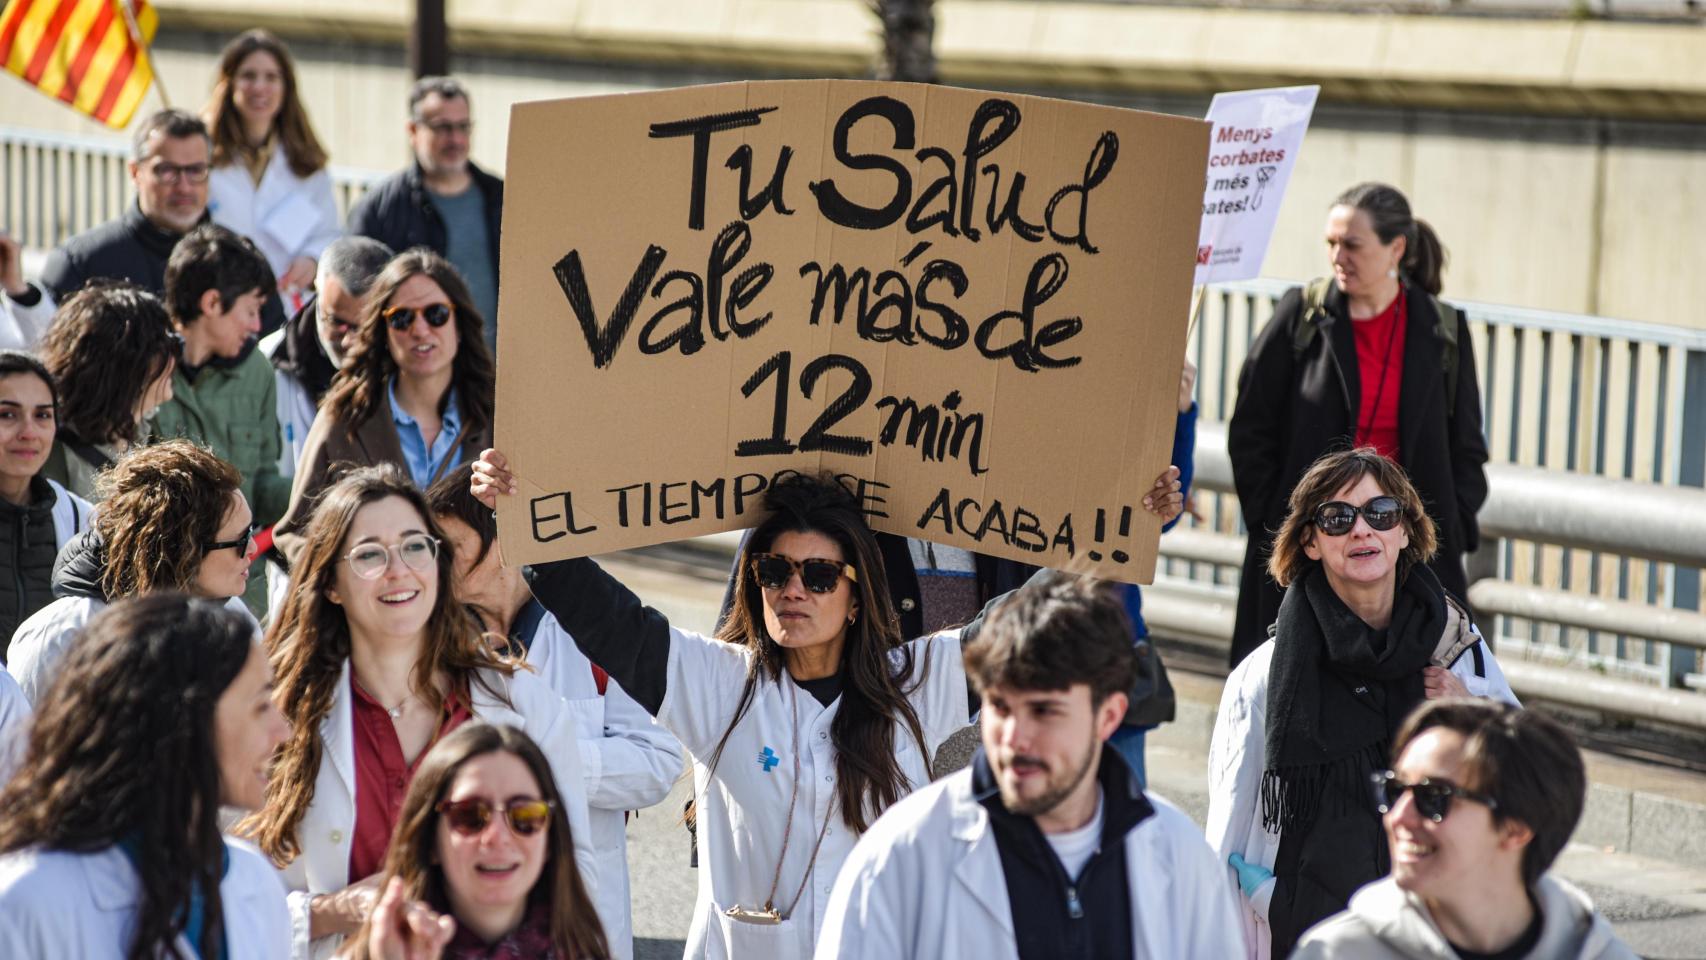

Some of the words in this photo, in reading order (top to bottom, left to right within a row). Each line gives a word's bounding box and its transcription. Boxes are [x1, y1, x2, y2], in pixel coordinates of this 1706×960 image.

[1216, 126, 1274, 144] Menys
[648, 106, 795, 230] Tu
[808, 95, 1118, 254] Salud
[1210, 148, 1286, 168] corbates
[1213, 174, 1250, 191] més
[552, 219, 775, 370] Vale
[799, 241, 970, 351] más
[974, 251, 1083, 374] de
[530, 490, 598, 543] EL
